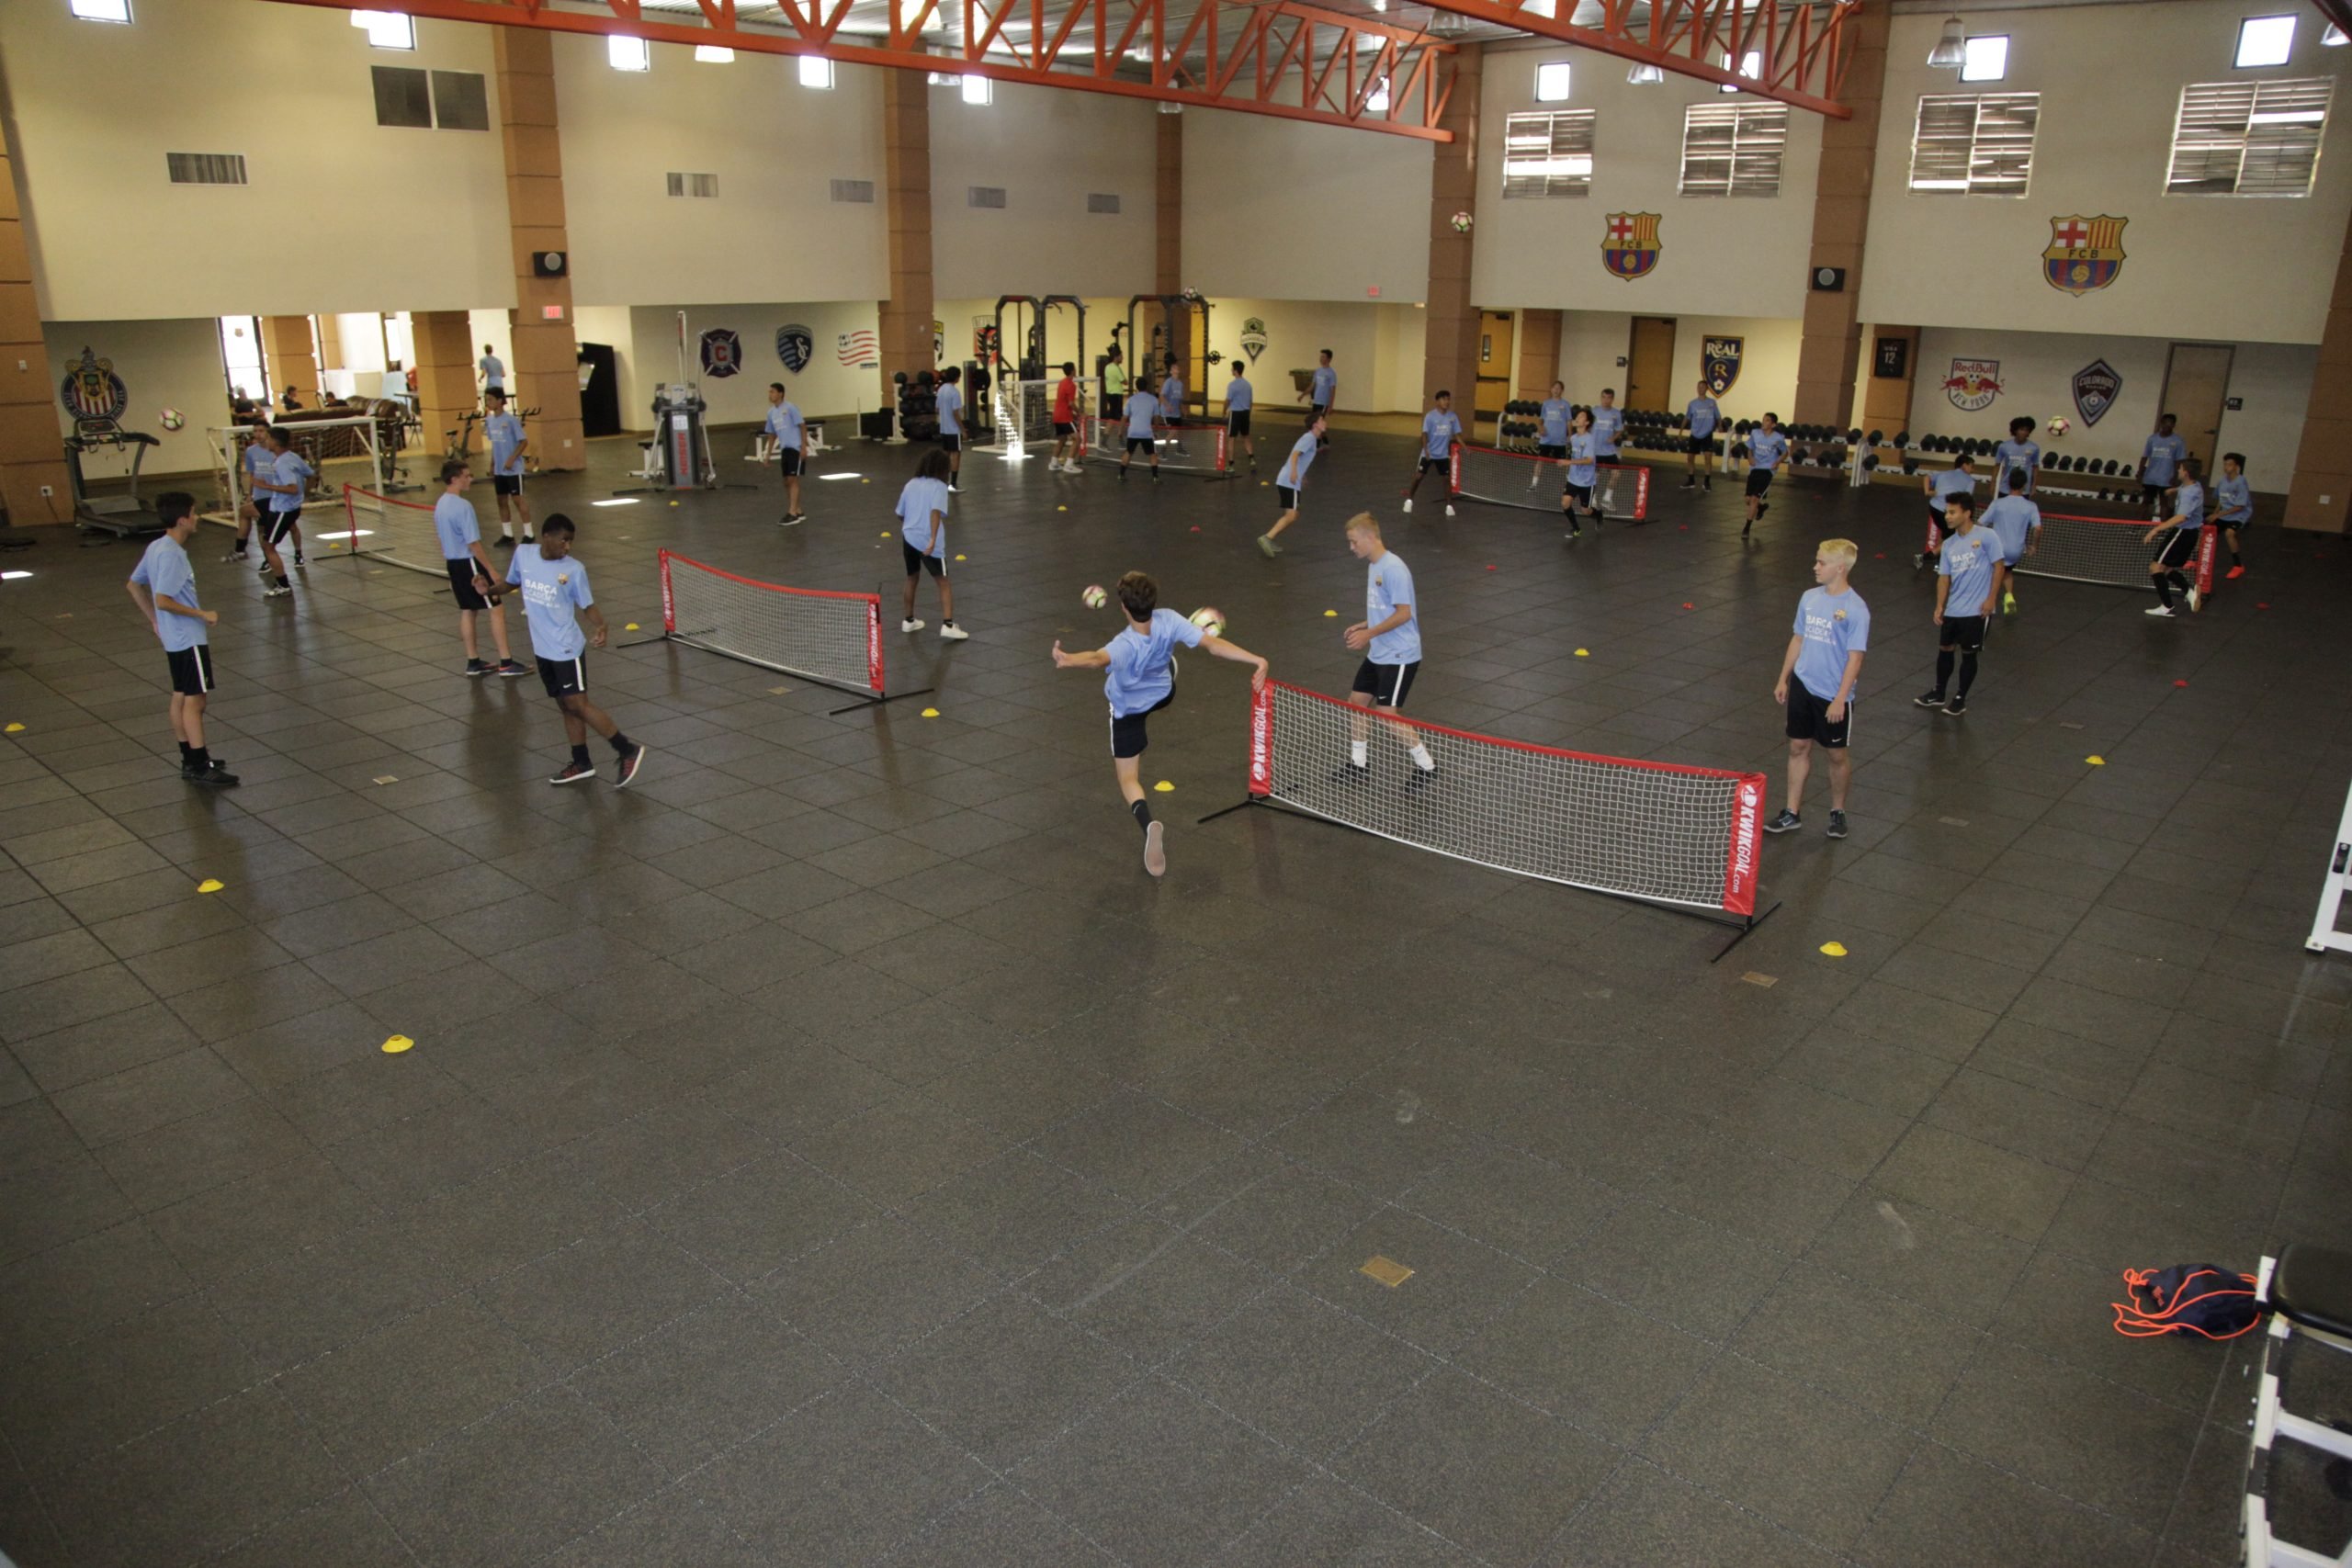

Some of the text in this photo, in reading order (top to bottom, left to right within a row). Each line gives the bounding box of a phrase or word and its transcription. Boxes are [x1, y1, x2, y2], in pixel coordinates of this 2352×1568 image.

[1620, 241, 1642, 249] FCB
[2068, 249, 2099, 258] FCB
[714, 344, 728, 362] C
[1884, 352, 1896, 365] 12
[1254, 690, 1266, 763] KWIKGOAL.com
[1732, 806, 1755, 894] KWIKGOAL.com
